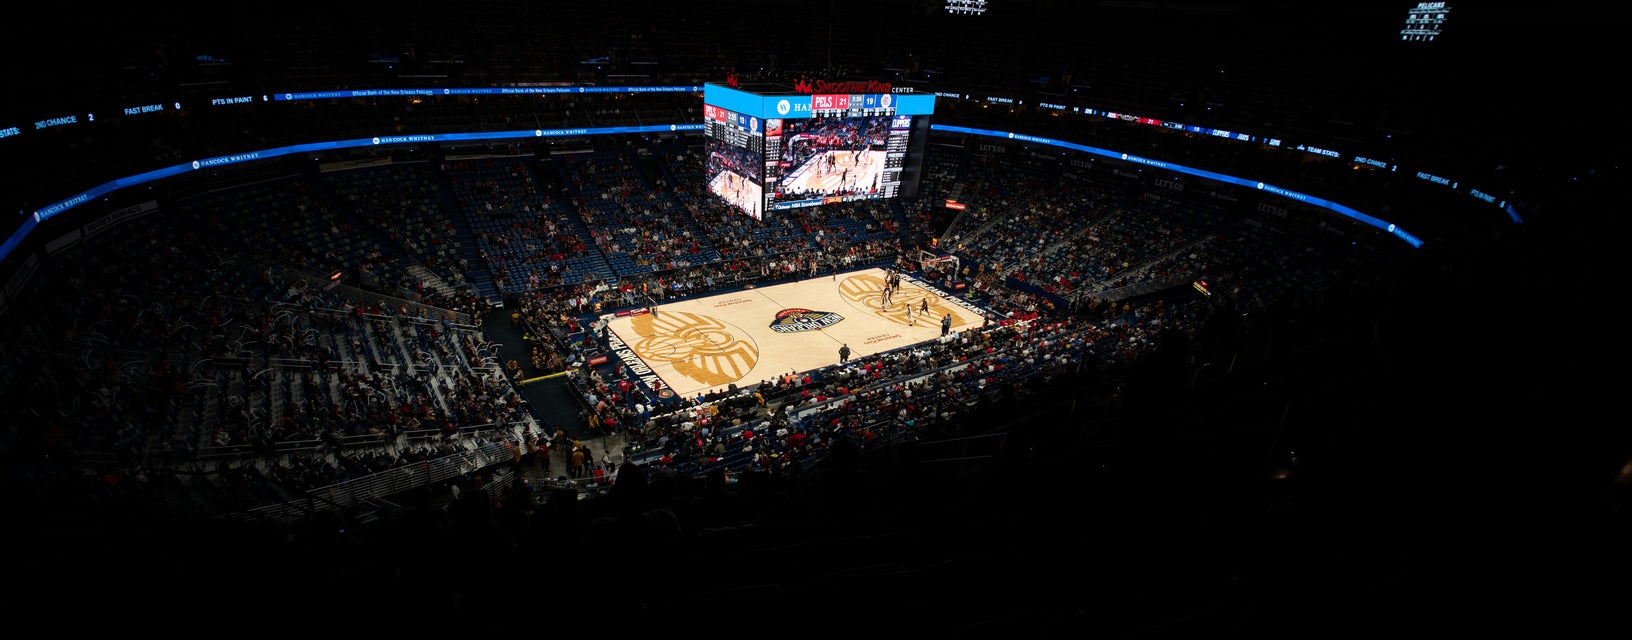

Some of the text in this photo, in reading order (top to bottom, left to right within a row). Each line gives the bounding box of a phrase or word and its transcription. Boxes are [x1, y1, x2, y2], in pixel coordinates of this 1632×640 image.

[815, 80, 866, 92] SMOOTHIE
[866, 80, 892, 92] KING
[815, 97, 832, 107] PELS
[124, 106, 141, 115] FAST
[142, 104, 163, 113] BREAK
[706, 106, 716, 118] PELS
[35, 121, 47, 129] 2ND
[47, 116, 77, 126] CHANCE
[892, 119, 910, 128] CLIPPERS
[0, 127, 21, 138] STATS:
[1322, 149, 1340, 157] STATS:
[201, 153, 259, 167] HANCOCK WHITNEY
[1367, 158, 1387, 168] CHANCE
[1417, 172, 1430, 180] FAST
[1430, 175, 1450, 185] BREAK
[1174, 183, 1184, 191] GO
[40, 194, 88, 218] HANCOCK WHITNEY
[913, 280, 948, 298] ORLEANS
[772, 320, 821, 333] ORLEANS
[820, 313, 842, 328] NEW
[616, 350, 652, 376] ORLEANS
